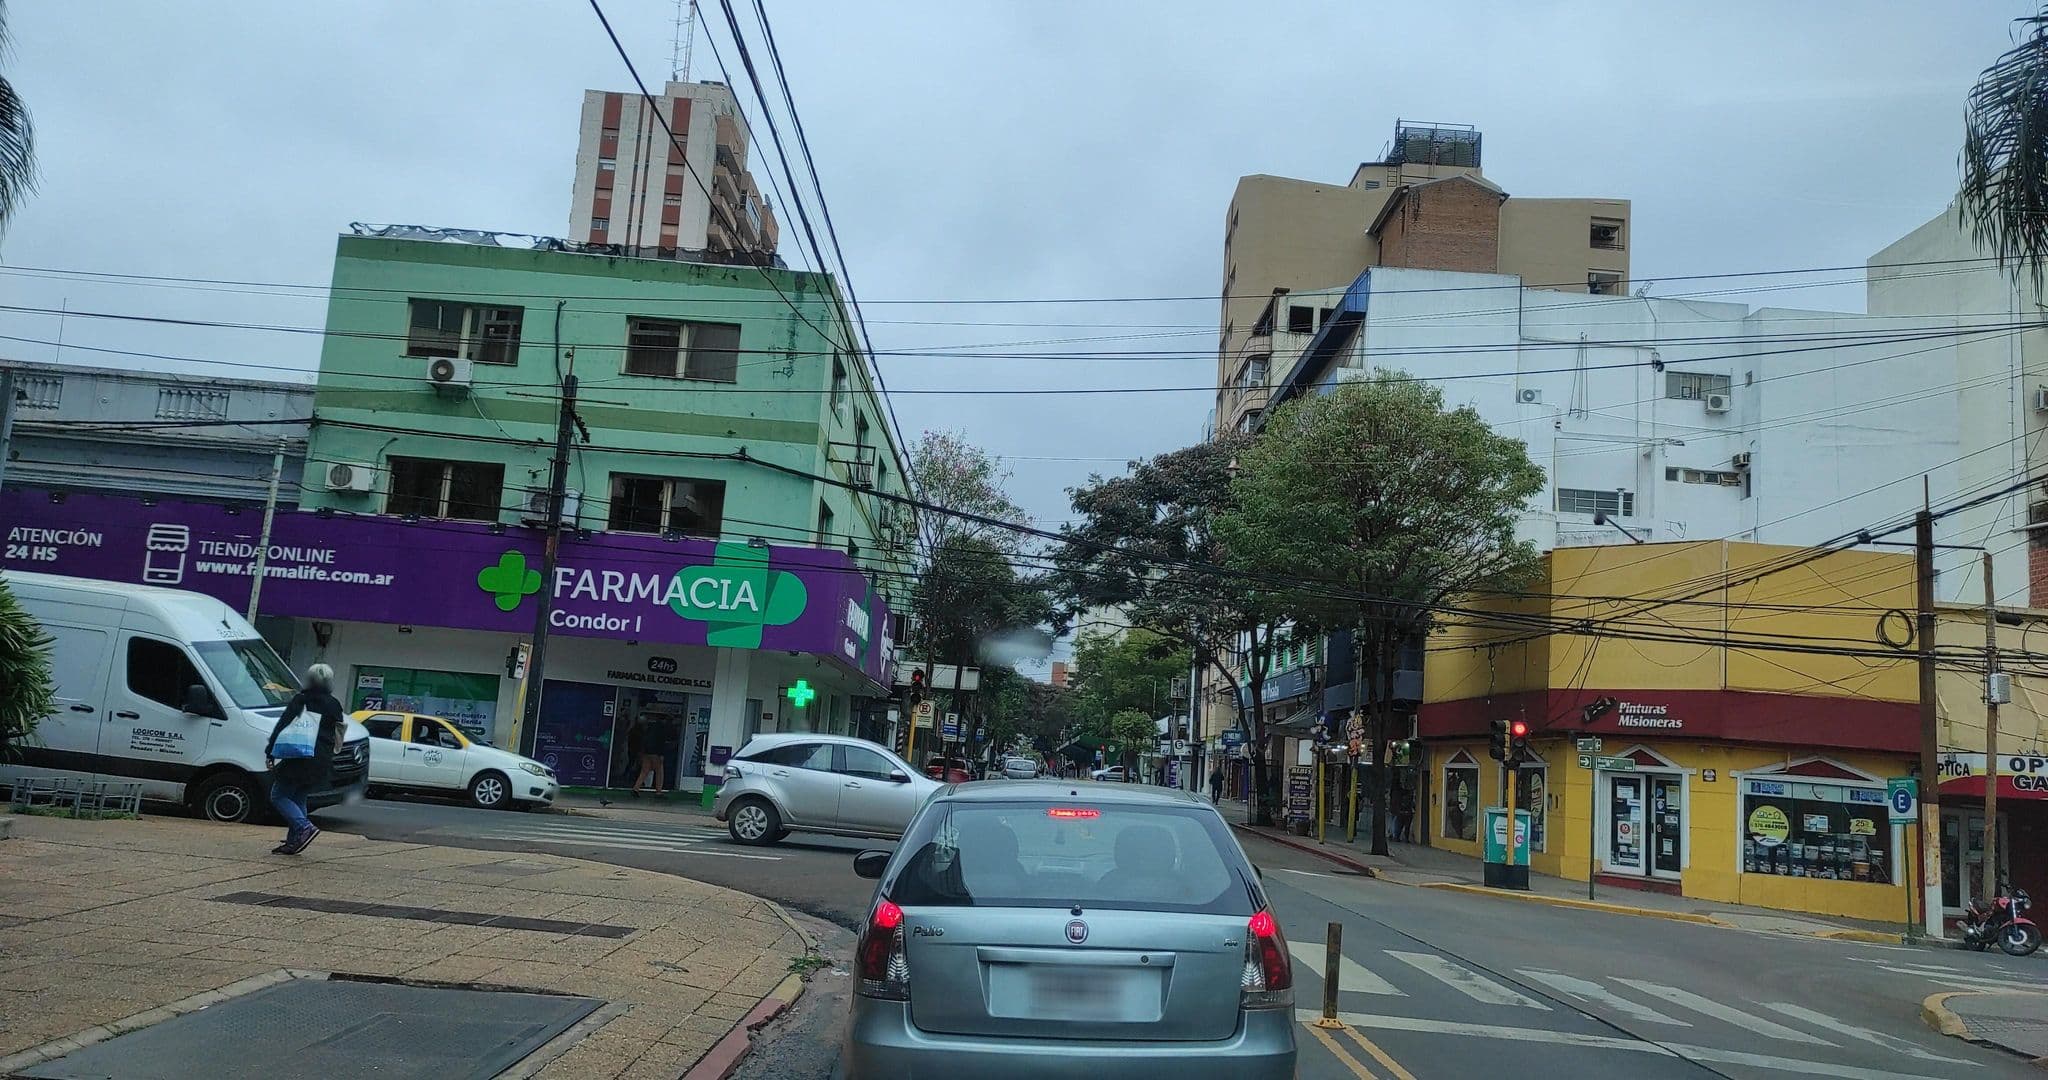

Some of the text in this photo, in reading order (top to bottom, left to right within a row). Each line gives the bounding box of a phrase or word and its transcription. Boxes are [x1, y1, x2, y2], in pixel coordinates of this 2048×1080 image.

[8, 527, 103, 547] ATENCIÓN
[5, 544, 58, 561] 24 HS
[267, 545, 336, 564] ONLINE
[553, 566, 759, 612] FARMACIA
[549, 609, 630, 631] Condor
[651, 660, 675, 671] 24hs
[607, 670, 646, 682] FARMACIA
[647, 674, 657, 683] EL
[657, 675, 692, 687] CONDOR
[365, 700, 382, 711] 24
[1619, 702, 1667, 714] Pinturas
[949, 714, 955, 724] E
[1619, 714, 1683, 728] Misioneras
[1937, 763, 1970, 776] PTICA
[2009, 757, 2048, 773] OP
[2013, 775, 2048, 791] GA
[1898, 794, 1906, 809] E
